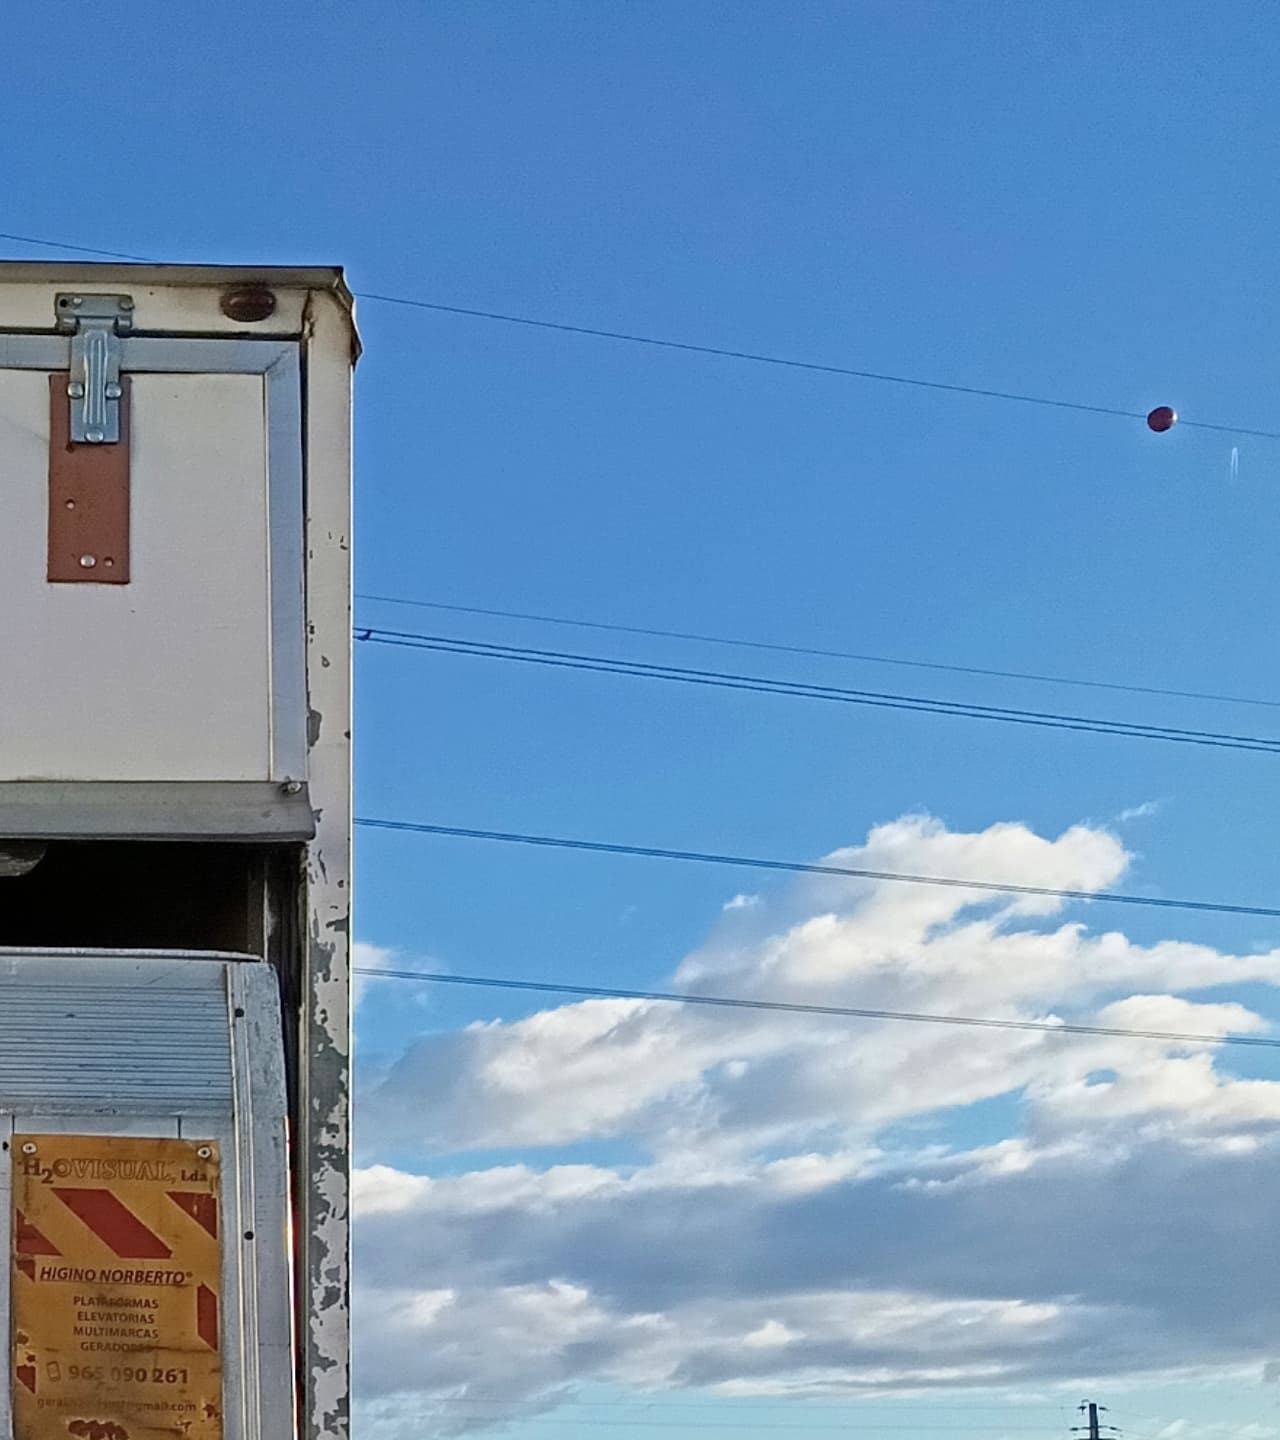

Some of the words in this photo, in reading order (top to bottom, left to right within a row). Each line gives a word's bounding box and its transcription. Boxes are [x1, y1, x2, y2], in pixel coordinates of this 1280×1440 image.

[40, 1266, 96, 1282] HIGINO
[73, 1325, 159, 1339] MULTIMARCAS
[111, 1366, 147, 1383] 090
[152, 1368, 189, 1384] 261
